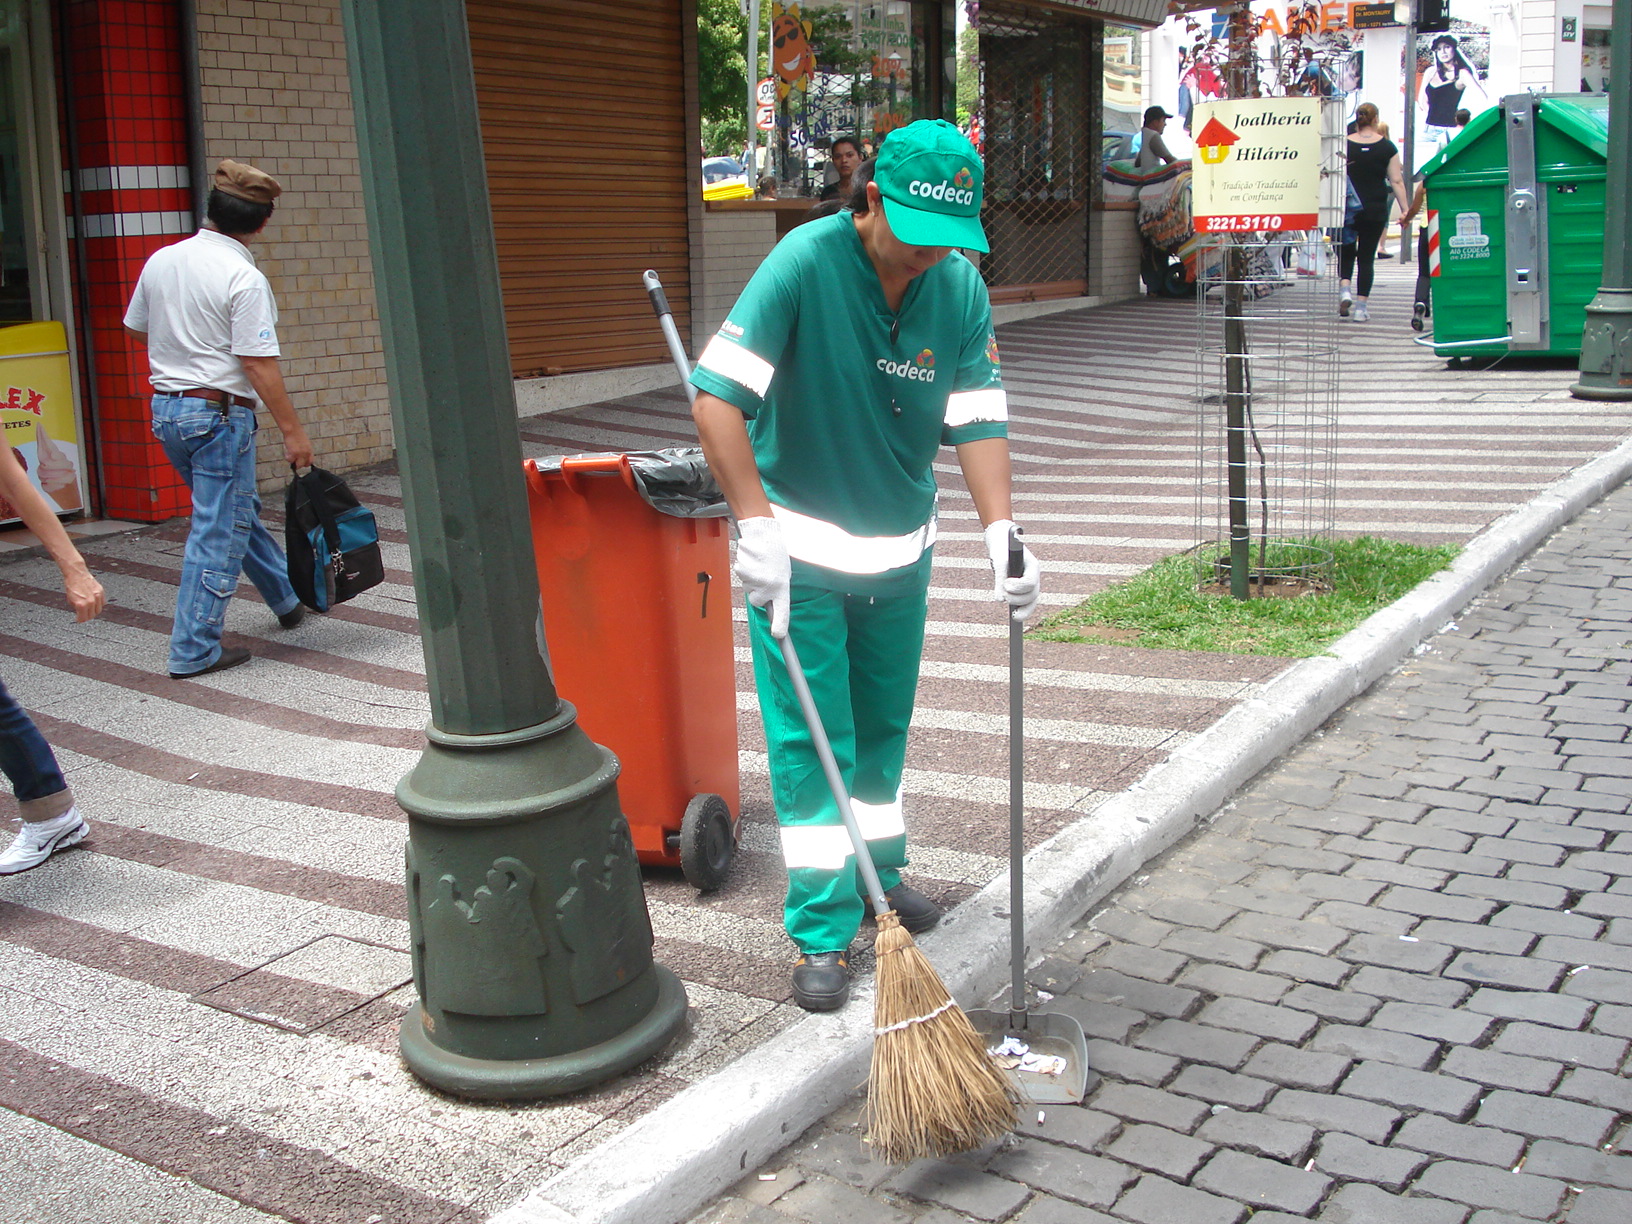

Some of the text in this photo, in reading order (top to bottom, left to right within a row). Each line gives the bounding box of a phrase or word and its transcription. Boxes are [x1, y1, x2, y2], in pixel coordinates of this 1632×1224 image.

[1363, 9, 1391, 17] MONTAURY
[1233, 112, 1312, 130] Joalheria
[1235, 146, 1299, 162] Hilário
[1222, 179, 1299, 191] Tradição Traduzida
[909, 180, 974, 206] codeca
[1242, 191, 1284, 204] Confiança
[1206, 216, 1282, 230] 3221.3110
[1462, 246, 1490, 254] CODECA
[876, 358, 936, 383] codeca
